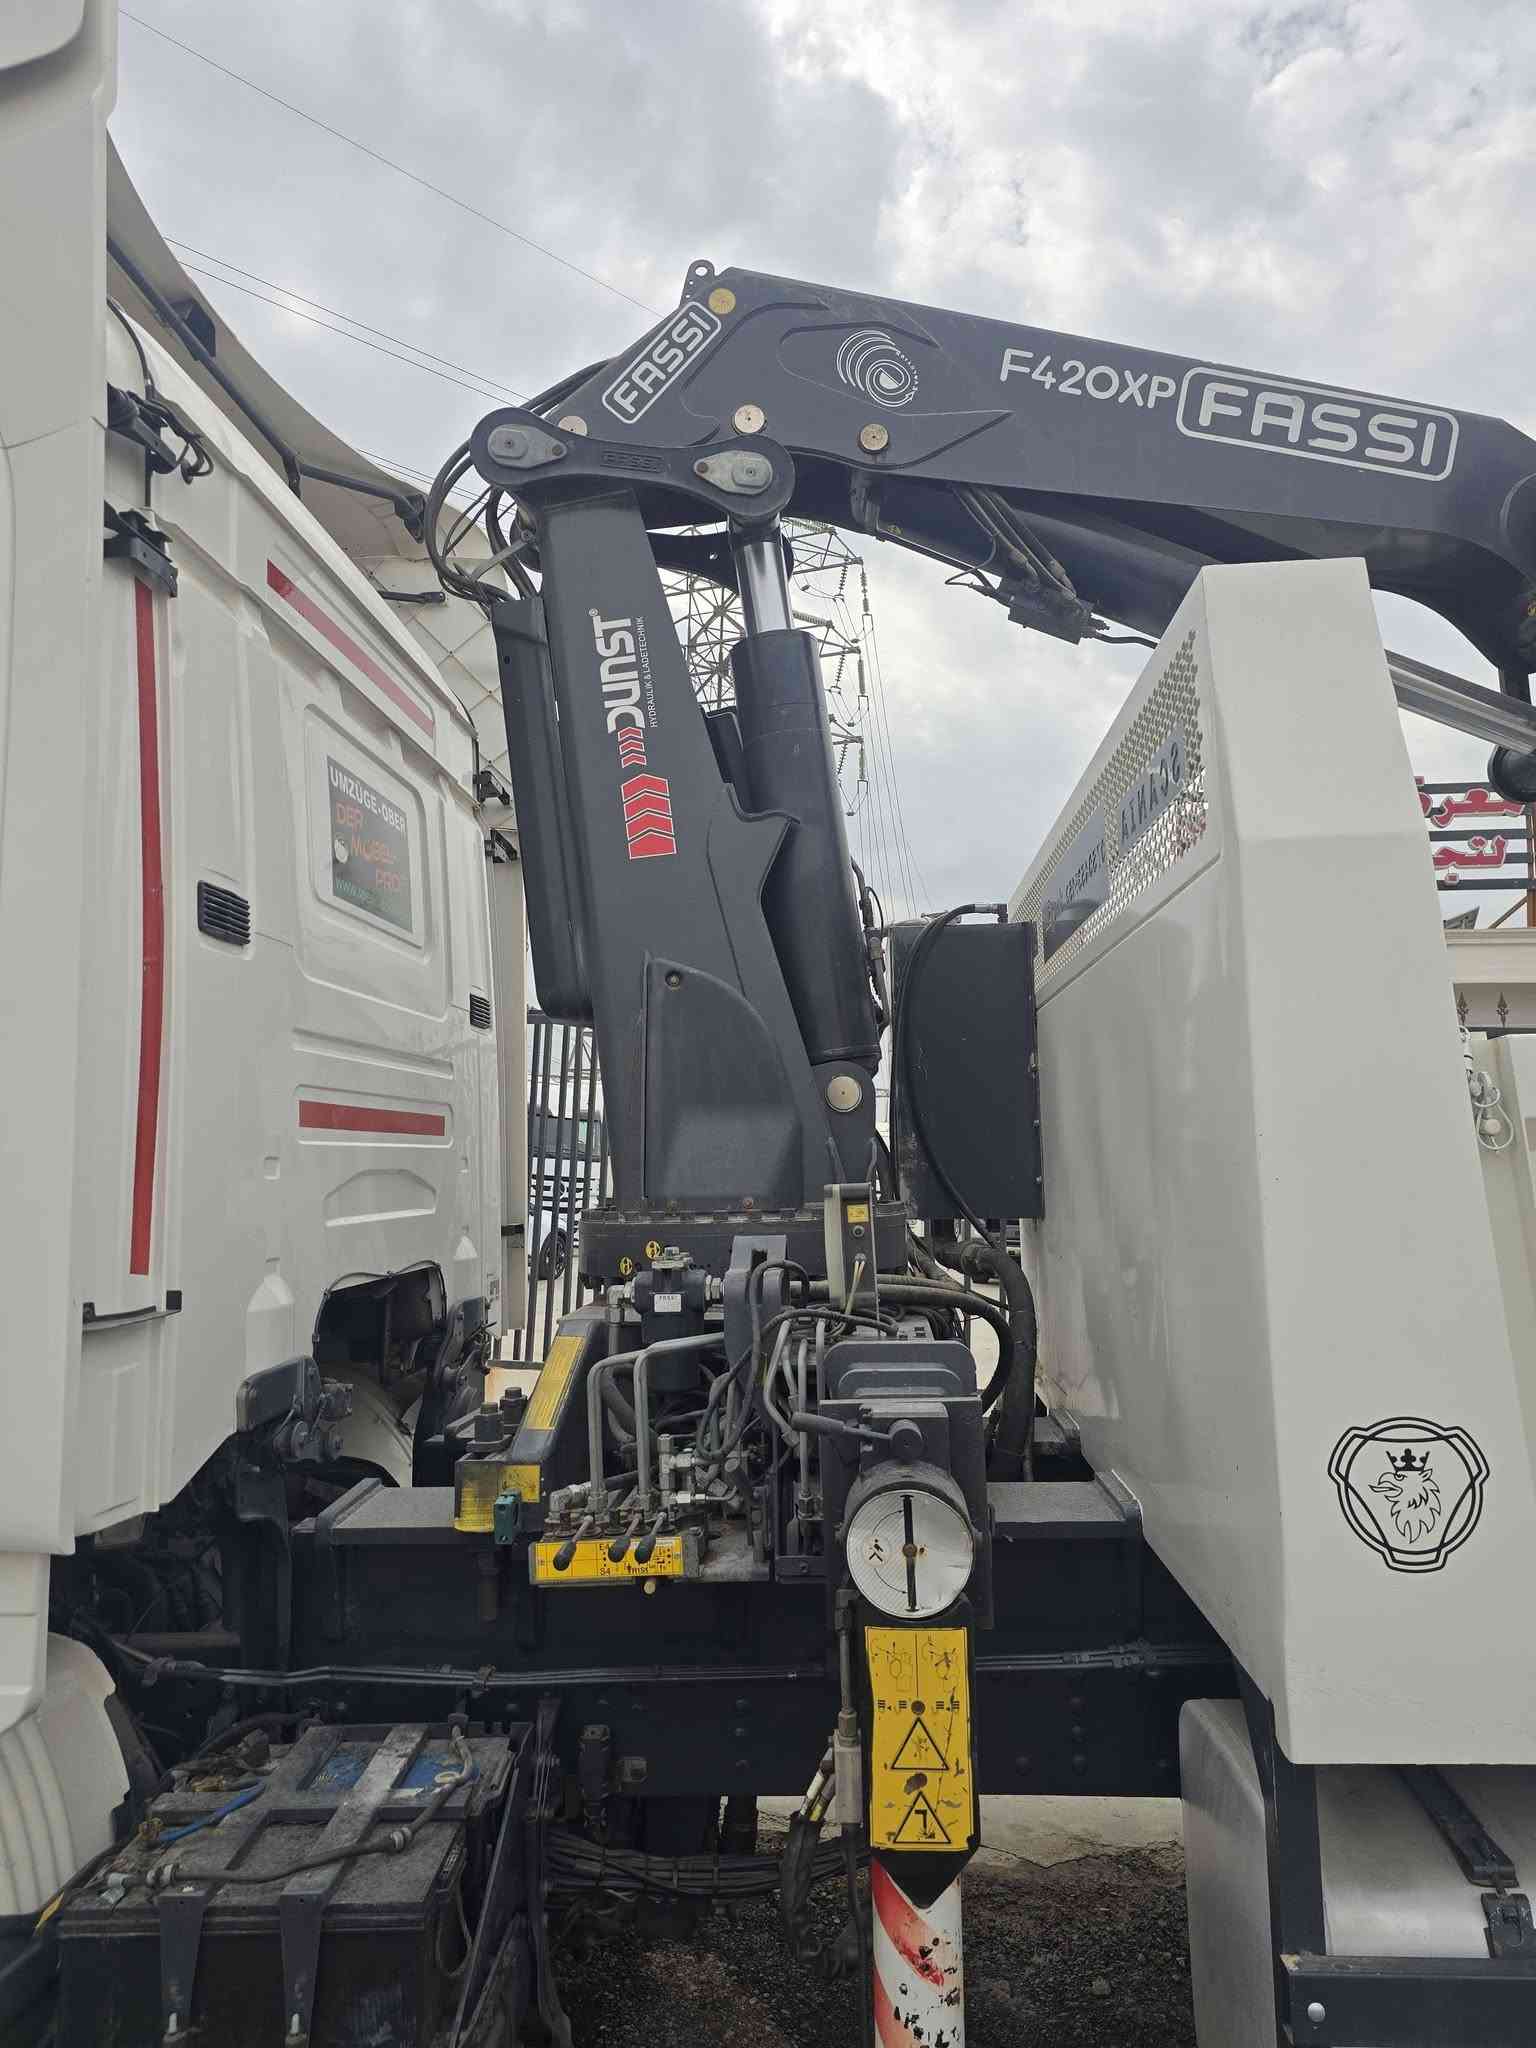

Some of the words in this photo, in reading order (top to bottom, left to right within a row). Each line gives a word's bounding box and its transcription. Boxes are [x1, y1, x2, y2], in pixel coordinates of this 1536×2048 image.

[613, 310, 712, 414] FASSI
[1000, 347, 1176, 409] F420XP
[1199, 382, 1437, 467] FASSI
[636, 616, 650, 673] LADETECHNIK
[643, 680, 658, 728] HYDRAULIK
